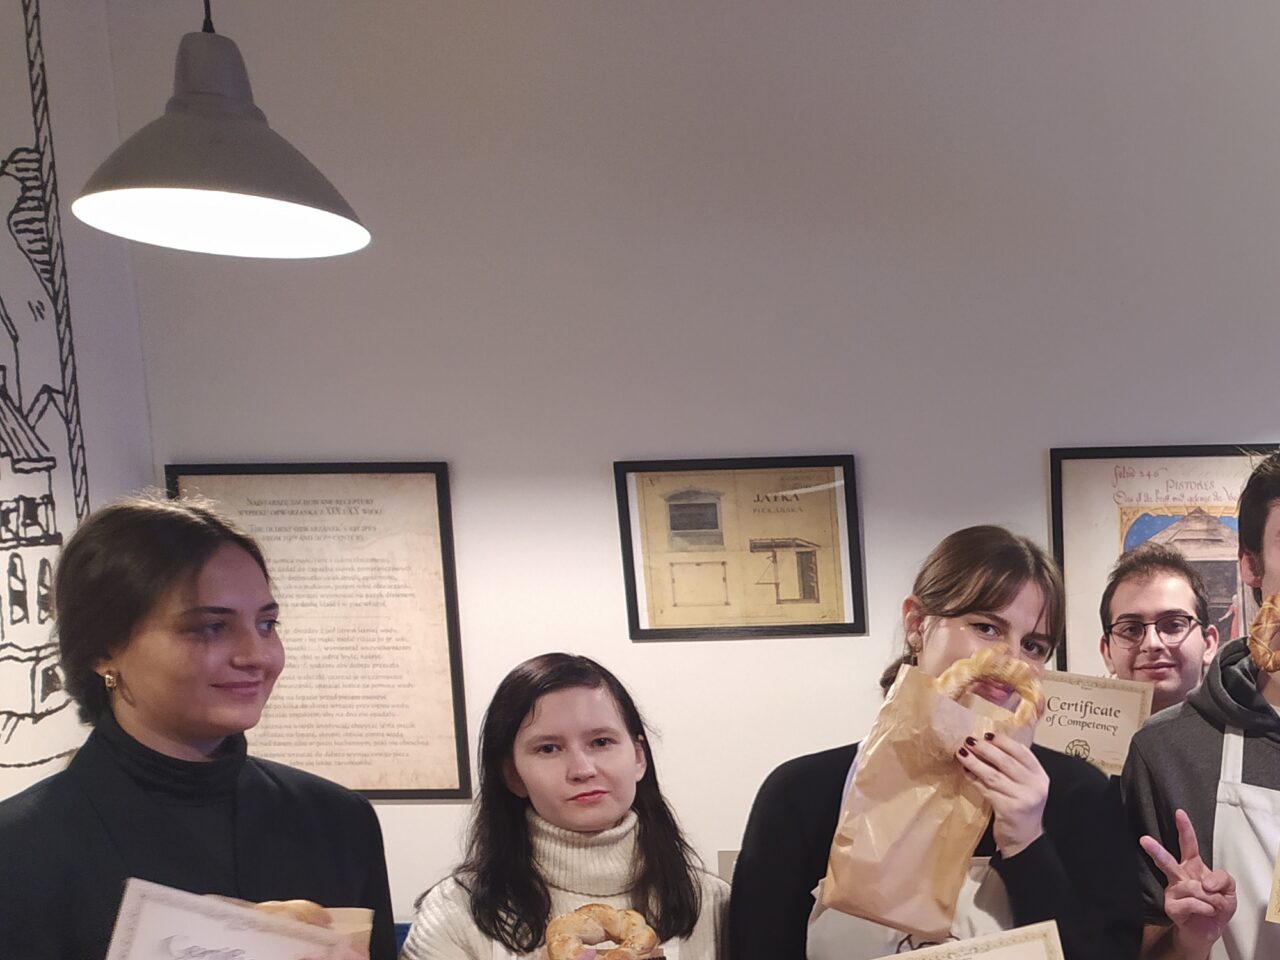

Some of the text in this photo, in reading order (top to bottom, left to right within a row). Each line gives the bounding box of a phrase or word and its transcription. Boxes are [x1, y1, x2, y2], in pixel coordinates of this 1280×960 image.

[1047, 696, 1121, 719] Certificate
[1045, 714, 1119, 736] of Competency
